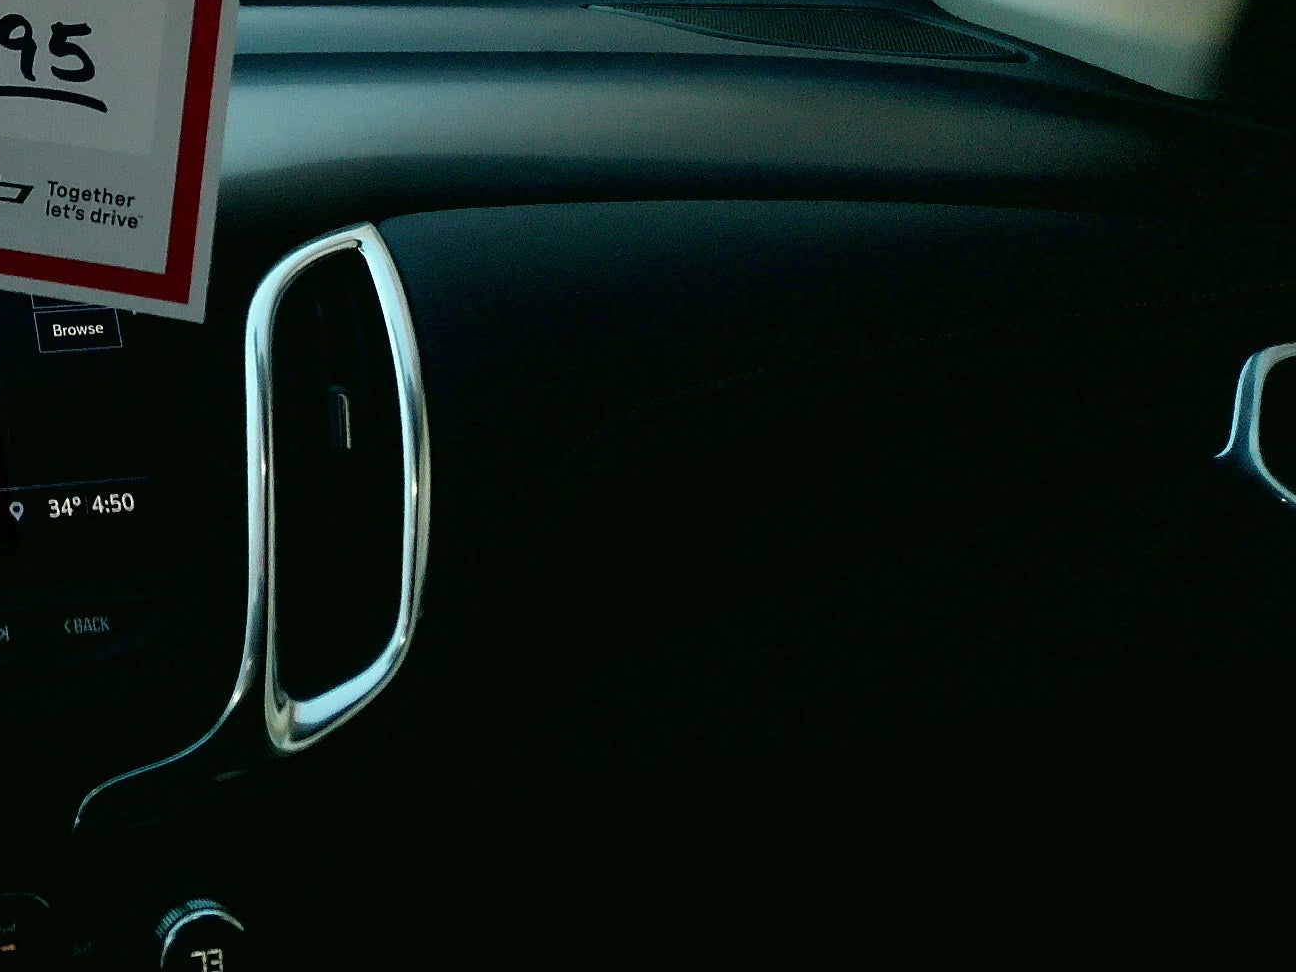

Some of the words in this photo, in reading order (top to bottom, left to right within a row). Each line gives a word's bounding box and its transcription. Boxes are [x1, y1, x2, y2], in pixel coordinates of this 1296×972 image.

[46, 180, 136, 208] Together
[45, 200, 85, 221] let's
[90, 207, 139, 229] drive
[52, 323, 105, 338] Browse
[47, 495, 82, 519] 34°
[91, 492, 136, 515] 4:50
[72, 616, 112, 635] BACK
